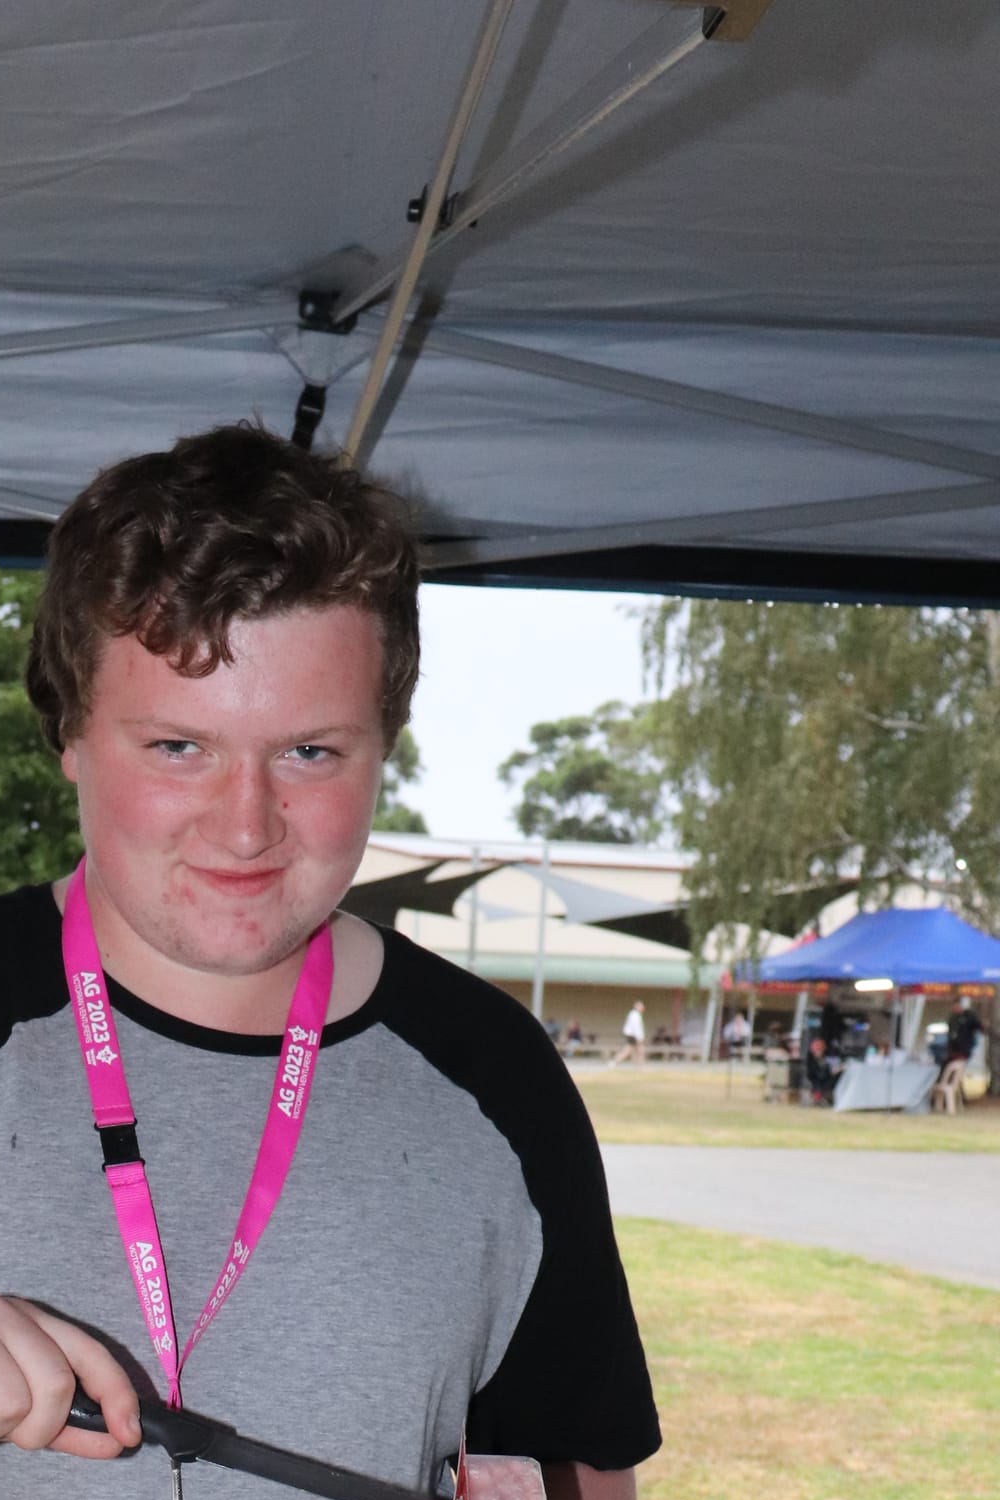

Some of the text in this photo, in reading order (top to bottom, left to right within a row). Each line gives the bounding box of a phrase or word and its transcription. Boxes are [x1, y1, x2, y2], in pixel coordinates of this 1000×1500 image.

[80, 971, 101, 998] AG
[86, 1000, 110, 1044] 2023
[277, 1044, 304, 1117] AG 2023
[136, 1241, 158, 1273] AG
[147, 1276, 167, 1329] 2023
[210, 1262, 236, 1310] 2023
